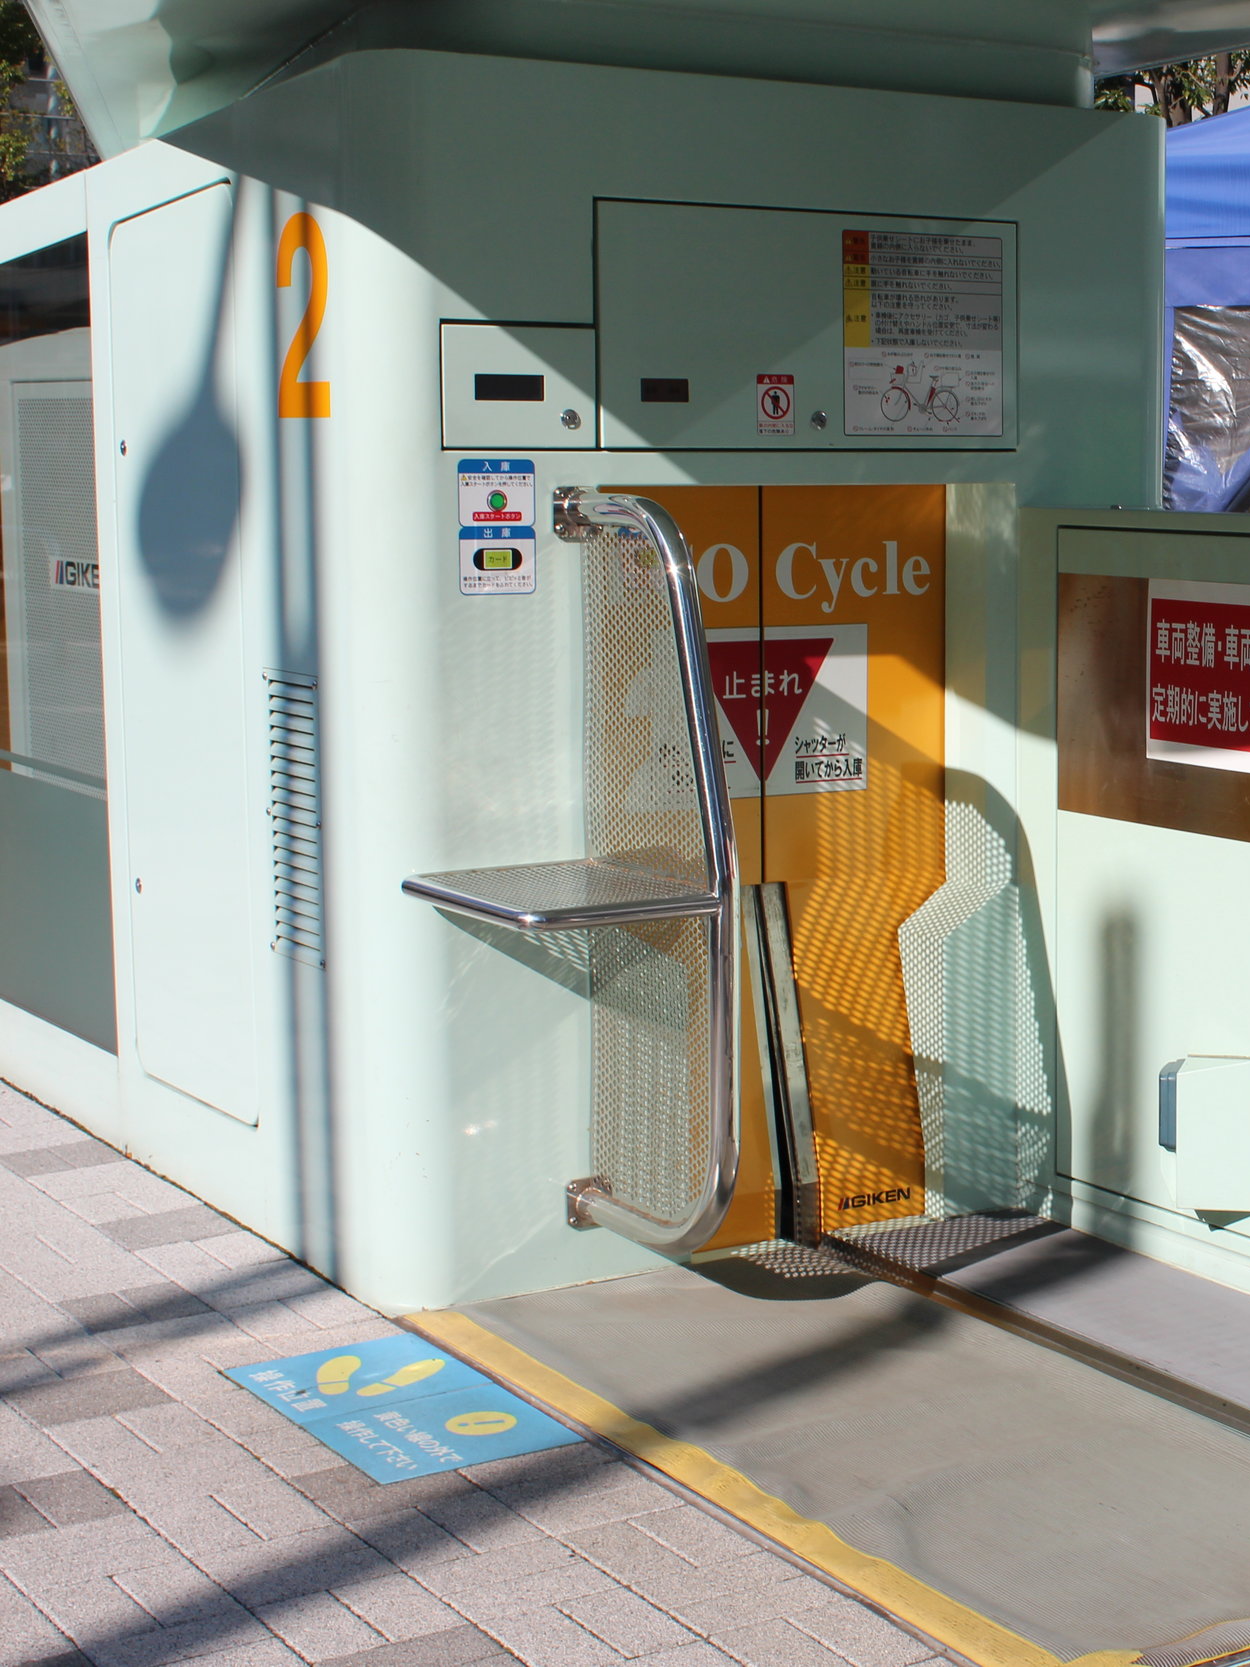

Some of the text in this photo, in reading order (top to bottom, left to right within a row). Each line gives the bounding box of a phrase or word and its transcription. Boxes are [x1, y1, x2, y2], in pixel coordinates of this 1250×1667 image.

[276, 212, 331, 418] 2
[483, 527, 511, 539] 出庫
[65, 561, 100, 589] GIKE
[775, 541, 931, 613] Cycle
[722, 669, 802, 700] 止まれ
[794, 734, 846, 755] シャッターが
[795, 758, 863, 781] 開いてから入庫
[851, 1187, 911, 1209] GIKEN
